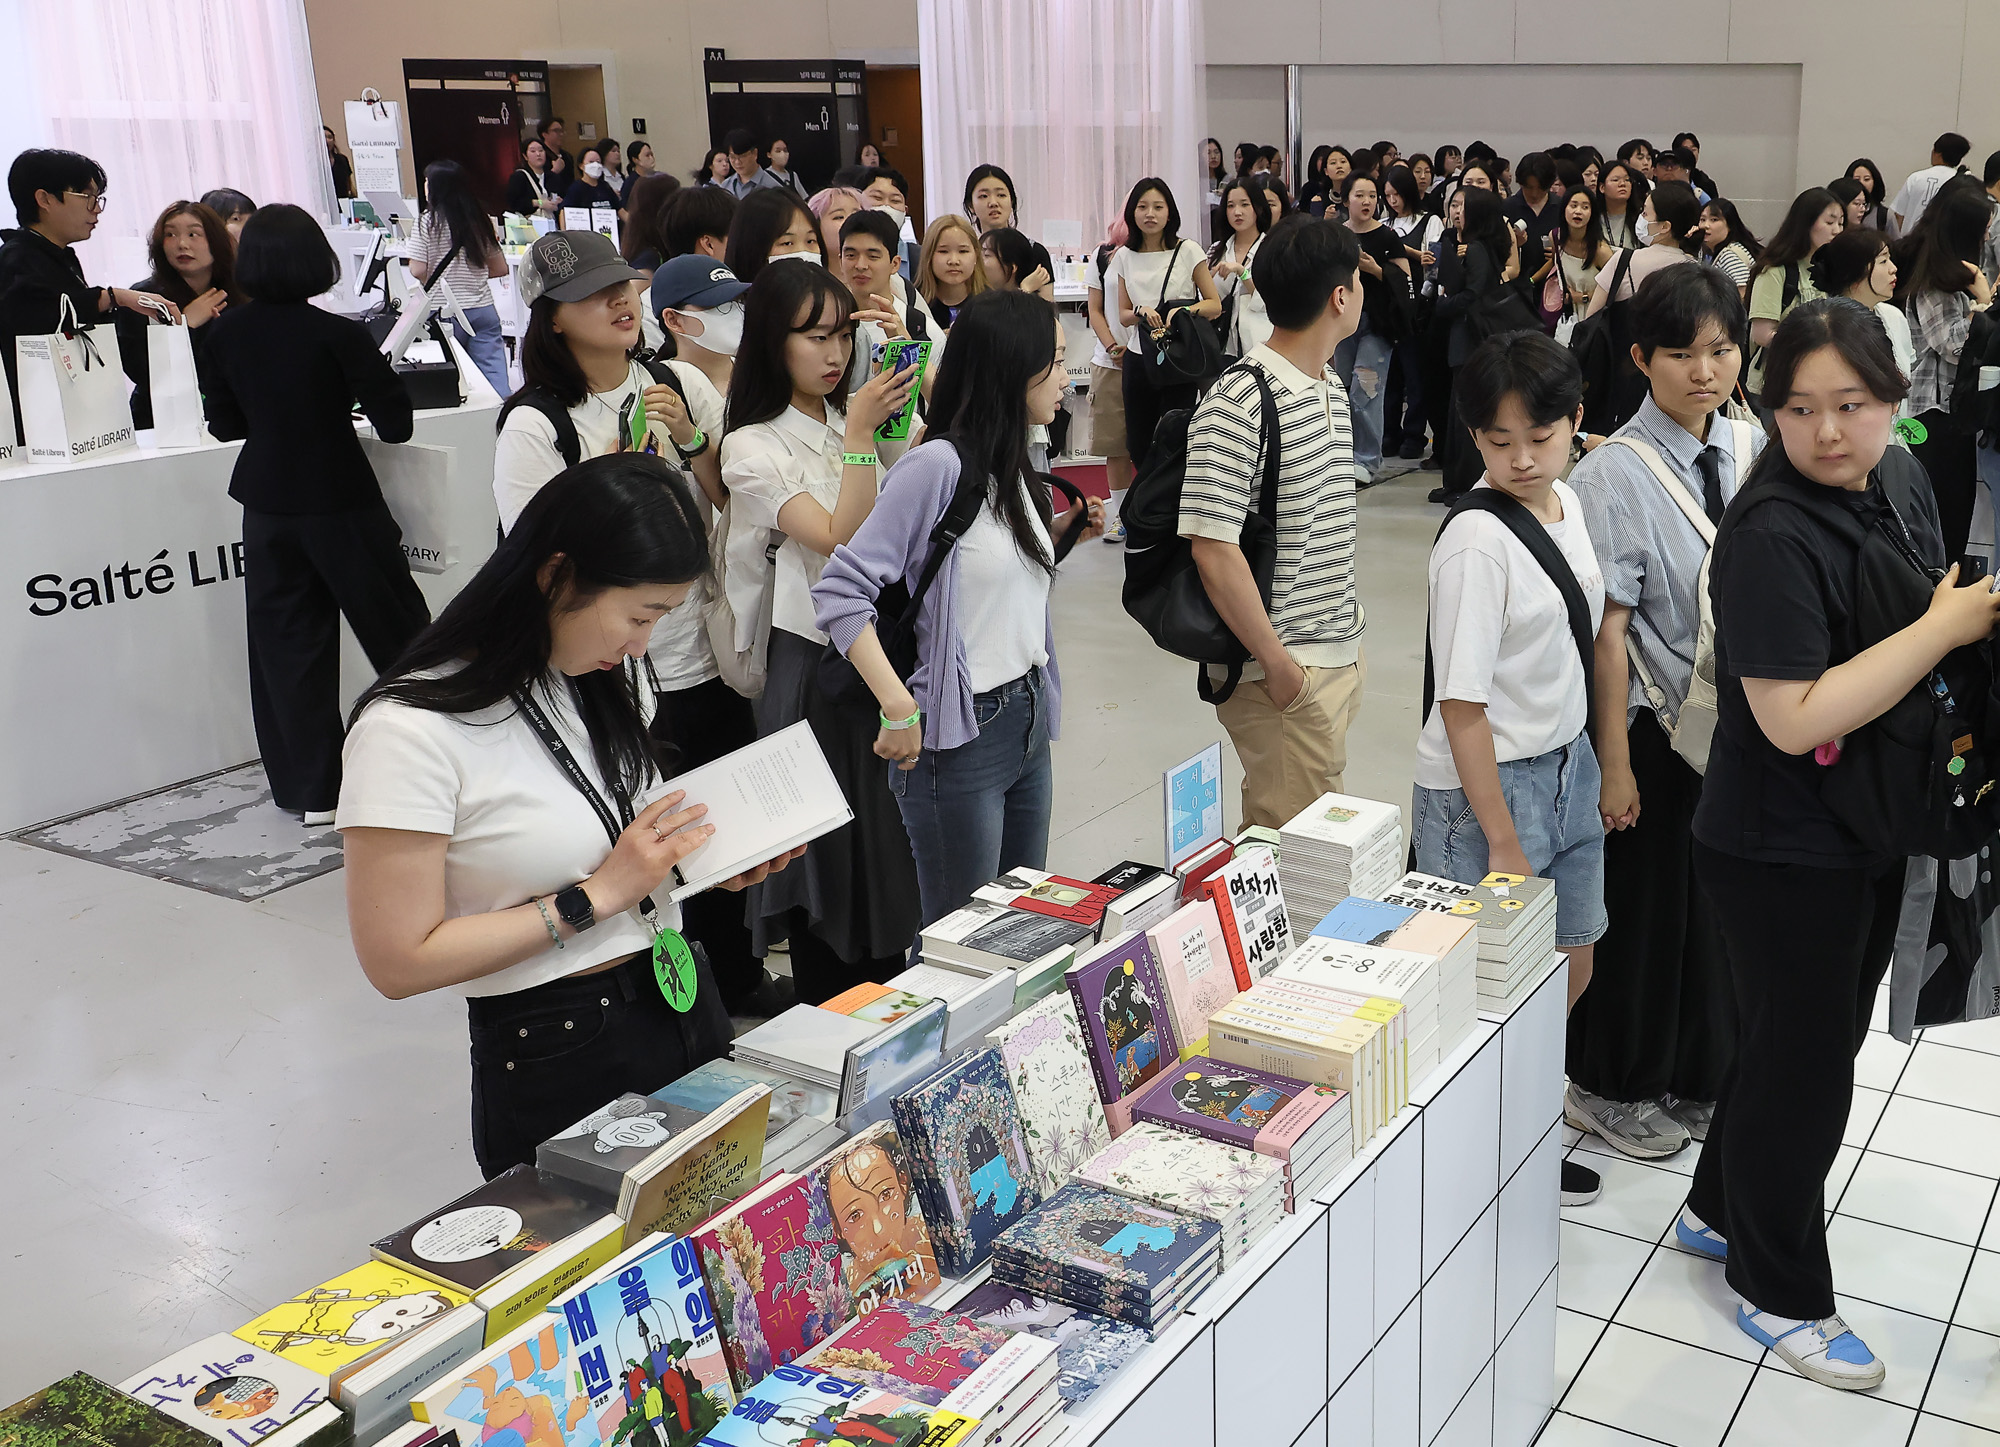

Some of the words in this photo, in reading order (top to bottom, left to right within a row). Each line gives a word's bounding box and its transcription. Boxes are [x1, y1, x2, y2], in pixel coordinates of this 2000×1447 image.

[478, 116, 500, 124] Women
[805, 122, 820, 131] Men
[71, 436, 95, 456] Salté
[97, 427, 131, 449] LIBRARY
[26, 548, 175, 617] Salté
[1175, 767, 1199, 793] 도서
[1176, 818, 1200, 844] 할인
[1230, 871, 1279, 897] 여자가
[1249, 913, 1289, 963] 사랑한
[1991, 985, 2000, 1015] Seoul
[1033, 1058, 1048, 1083] 한
[1048, 1095, 1073, 1121] 시간
[662, 1172, 698, 1199] Movie
[700, 1141, 739, 1174] Land's
[682, 1149, 712, 1175] Here
[715, 1139, 726, 1150] is
[640, 1205, 683, 1238] Sweet,
[687, 1177, 722, 1204] Spicy,
[725, 1155, 748, 1177] and
[666, 1185, 693, 1208] New
[698, 1160, 729, 1187] Menu
[775, 1194, 795, 1209] 장편소설
[654, 1206, 694, 1233] unchy
[859, 1253, 925, 1315] 아가미
[696, 1331, 714, 1348] 장편소설
